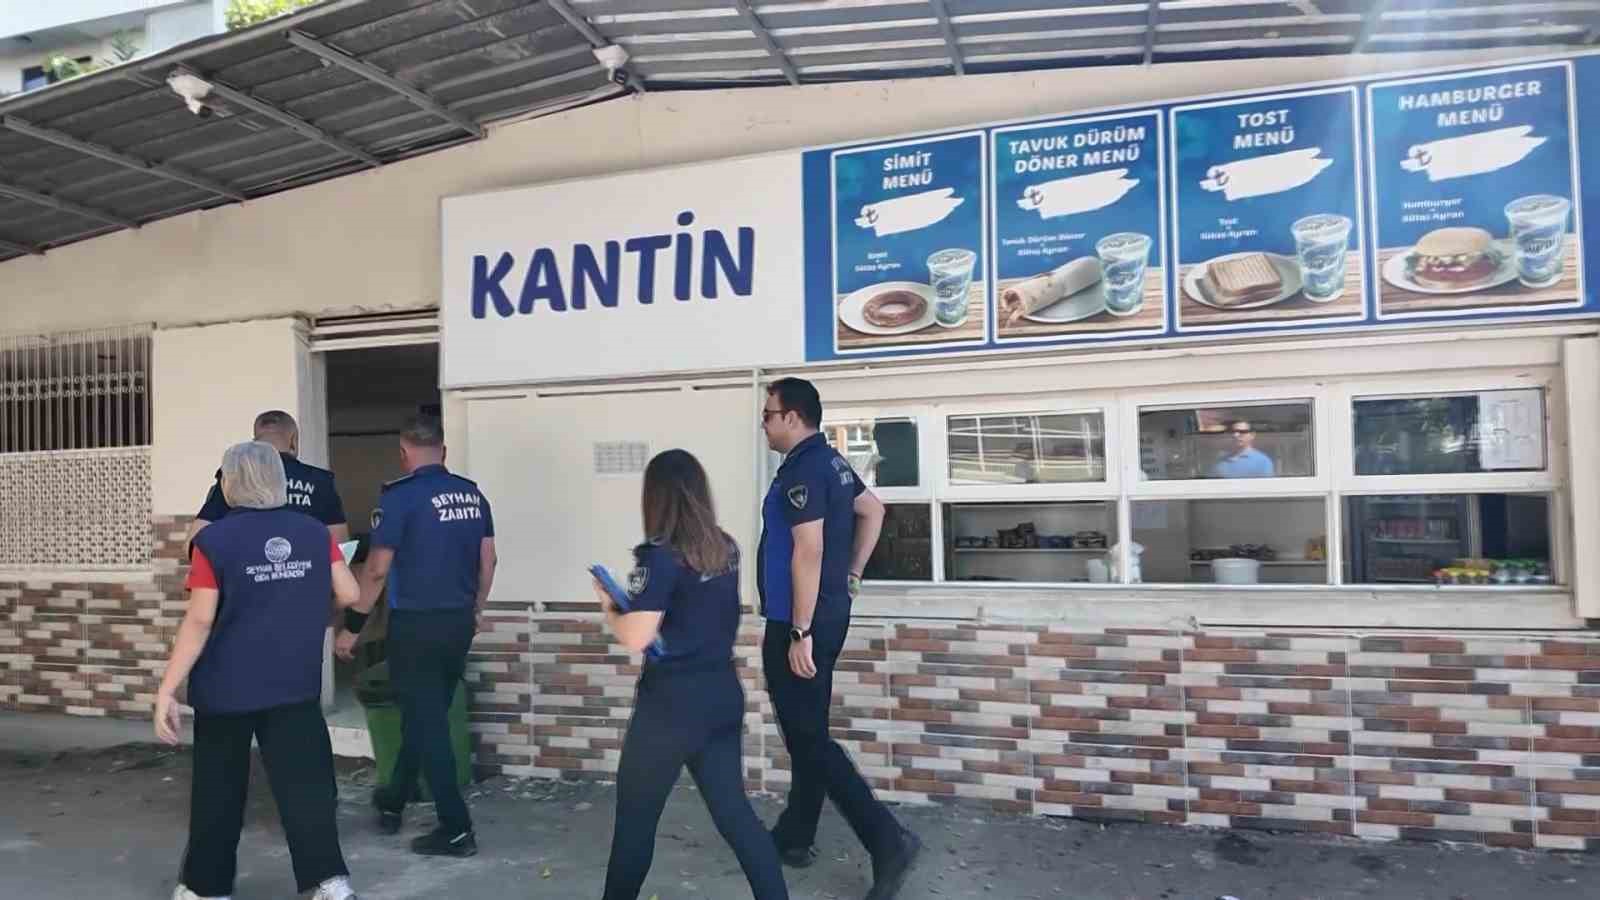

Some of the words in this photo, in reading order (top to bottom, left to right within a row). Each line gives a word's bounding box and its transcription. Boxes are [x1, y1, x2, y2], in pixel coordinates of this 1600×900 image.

[1398, 80, 1542, 110] HAMBURGER
[1237, 109, 1290, 128] TOST
[1437, 103, 1504, 128] MENÜ
[1009, 135, 1069, 154] TAVUK
[1073, 125, 1145, 148] DÜRÜM
[1233, 126, 1295, 150] MENÜ
[883, 151, 932, 171] SİMİT
[1015, 154, 1079, 173] DÖNER
[1083, 143, 1141, 166] MENÜ
[882, 168, 933, 190] MENÜ
[471, 211, 755, 319] KANTİN
[432, 491, 480, 508] SEYHAN
[438, 506, 481, 521] ZABITA
